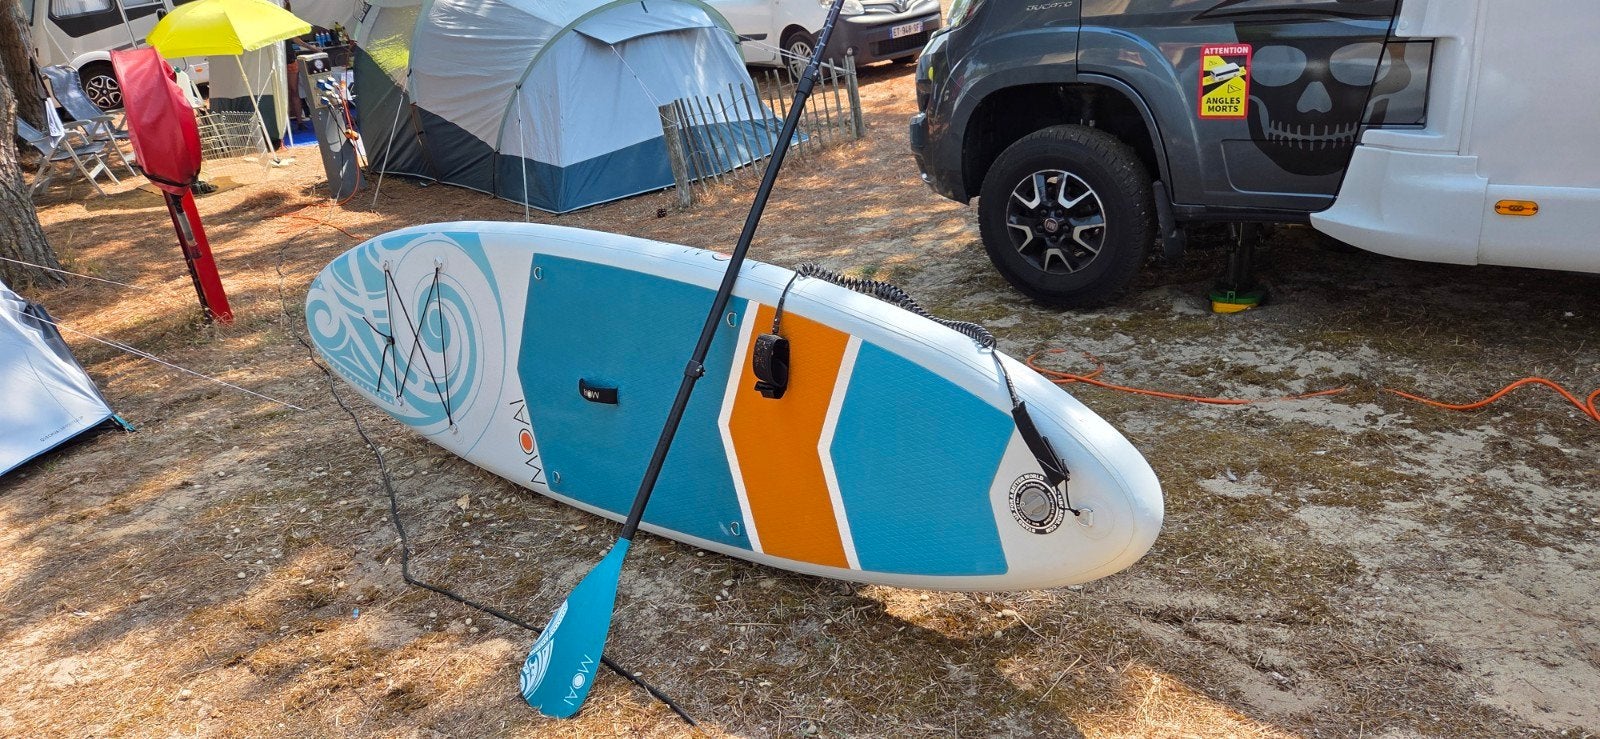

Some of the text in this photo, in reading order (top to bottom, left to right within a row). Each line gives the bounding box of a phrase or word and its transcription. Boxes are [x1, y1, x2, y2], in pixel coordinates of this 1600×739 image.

[1026, 2, 1073, 10] DUCATO
[1204, 46, 1249, 54] ATTENTION
[509, 399, 546, 484] MOAI
[1010, 476, 1025, 493] BETTER
[1018, 519, 1036, 533] STAND
[563, 654, 594, 706] MOAI
